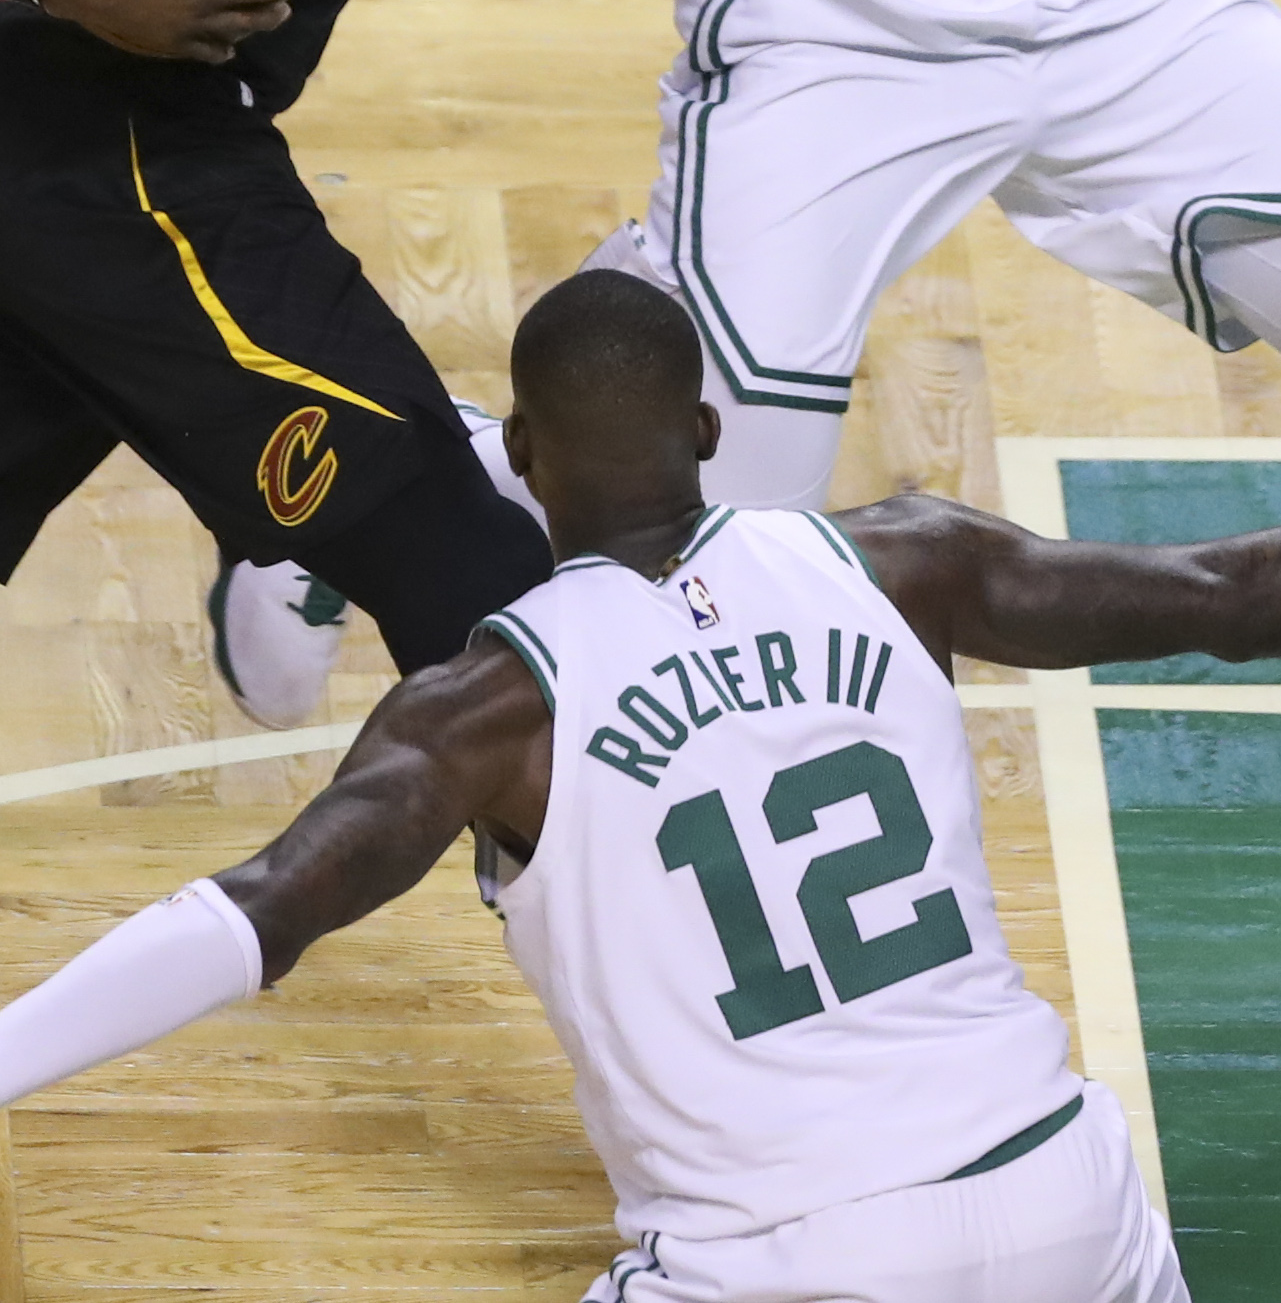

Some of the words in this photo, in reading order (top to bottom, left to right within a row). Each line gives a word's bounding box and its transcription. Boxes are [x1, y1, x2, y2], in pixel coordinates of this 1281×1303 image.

[257, 405, 338, 527] C
[585, 630, 807, 788] ROZIER
[826, 628, 893, 715] III
[655, 740, 974, 1042] 12
